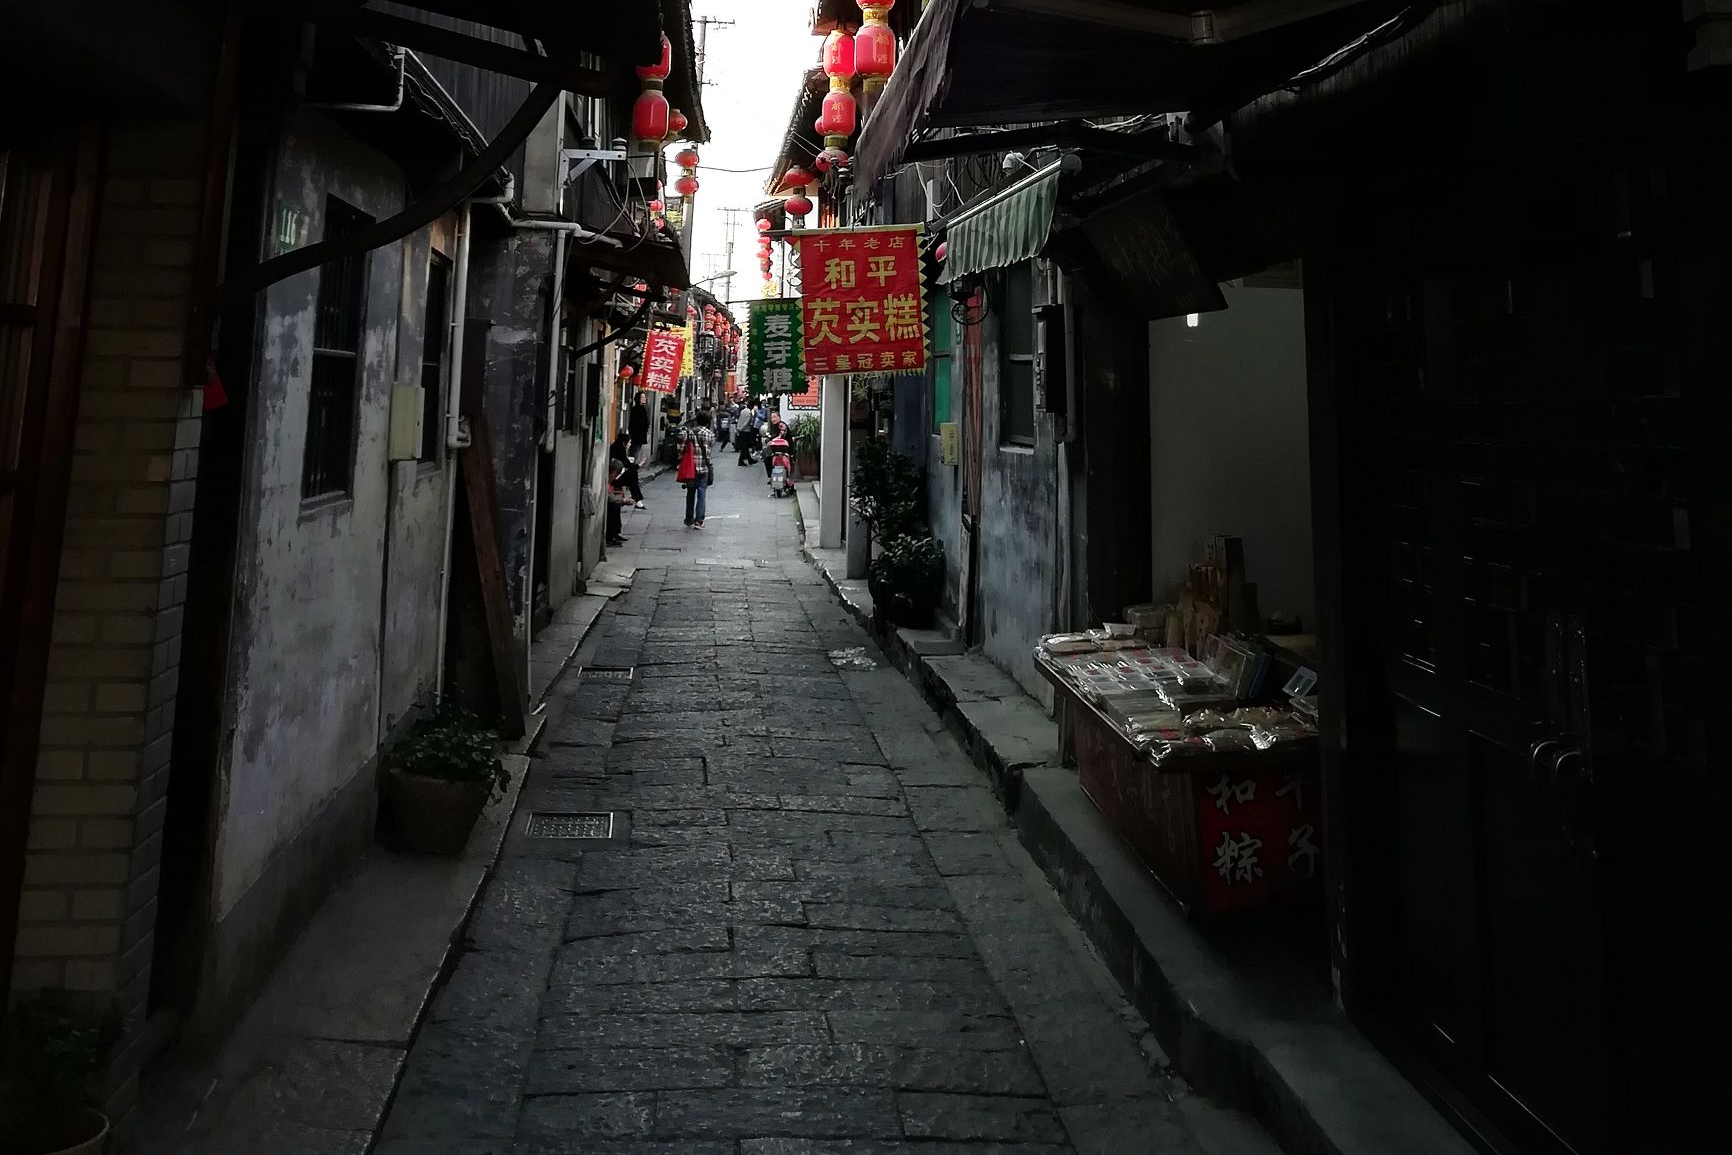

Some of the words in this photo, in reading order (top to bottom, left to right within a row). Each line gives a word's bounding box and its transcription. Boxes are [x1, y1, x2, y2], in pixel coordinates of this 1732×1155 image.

[813, 236, 905, 253] 十年老店
[824, 255, 897, 290] 和平
[807, 293, 920, 346] 芡实糕
[647, 338, 678, 389] 芡实糕
[763, 314, 792, 391] 麦芽糖
[813, 351, 917, 371] 三皇冠卖家
[1212, 823, 1320, 886] 粽子
